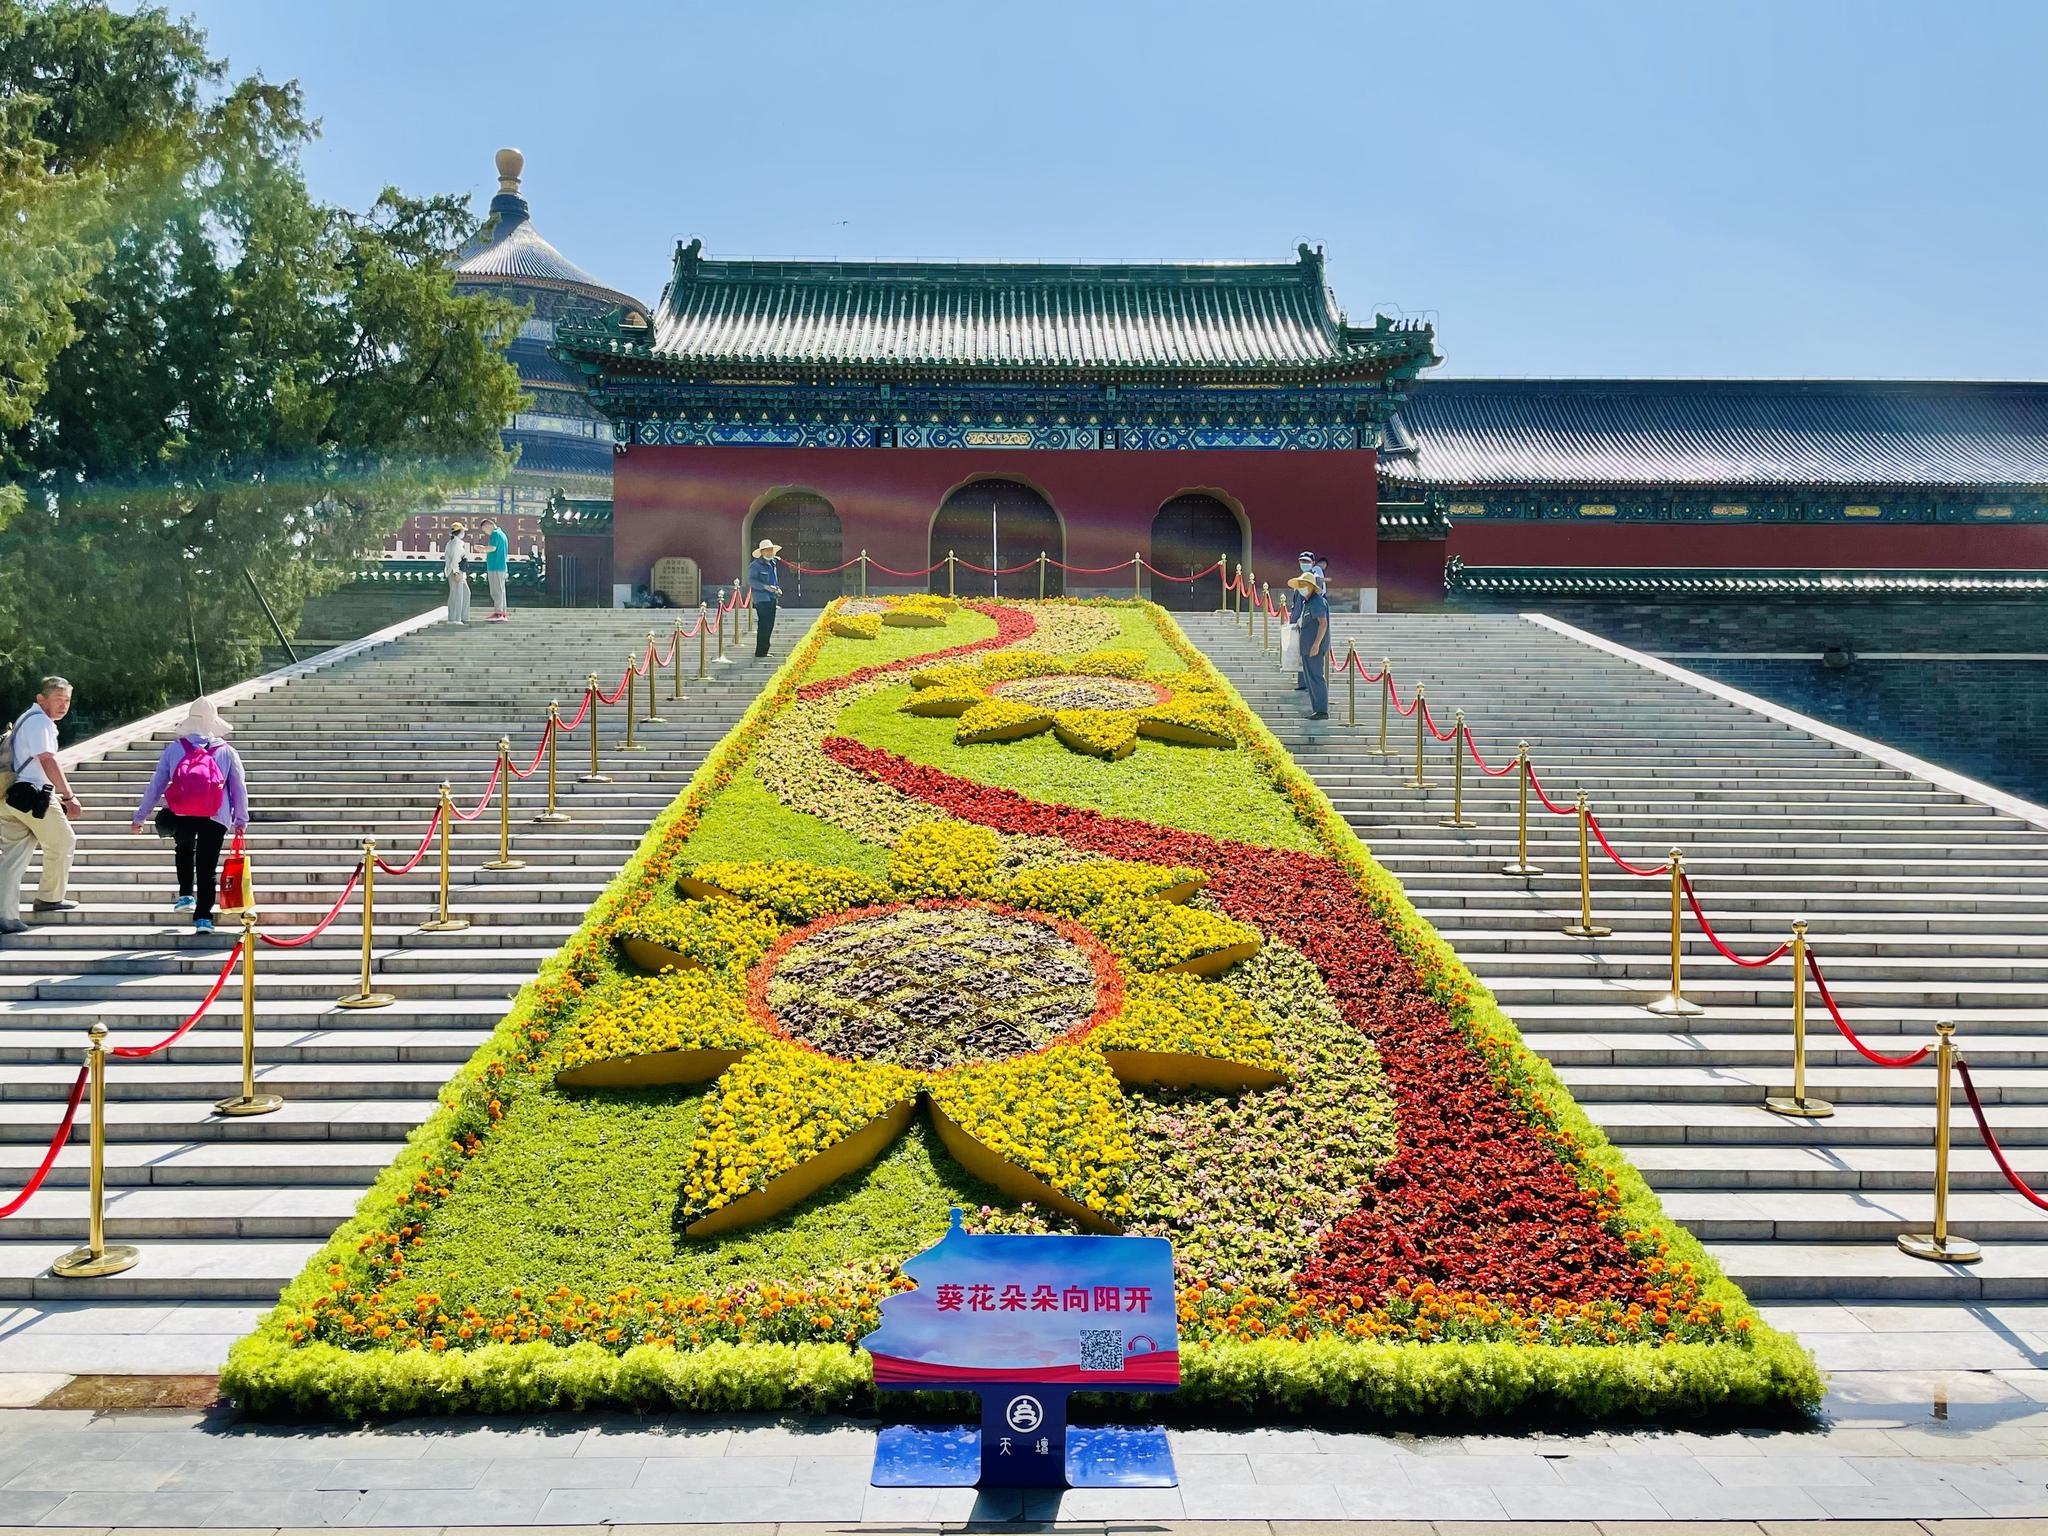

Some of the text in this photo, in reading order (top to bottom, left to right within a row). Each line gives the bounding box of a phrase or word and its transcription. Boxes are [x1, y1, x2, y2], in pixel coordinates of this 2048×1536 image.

[936, 1284, 1153, 1312] 葵花朵朵向阳开
